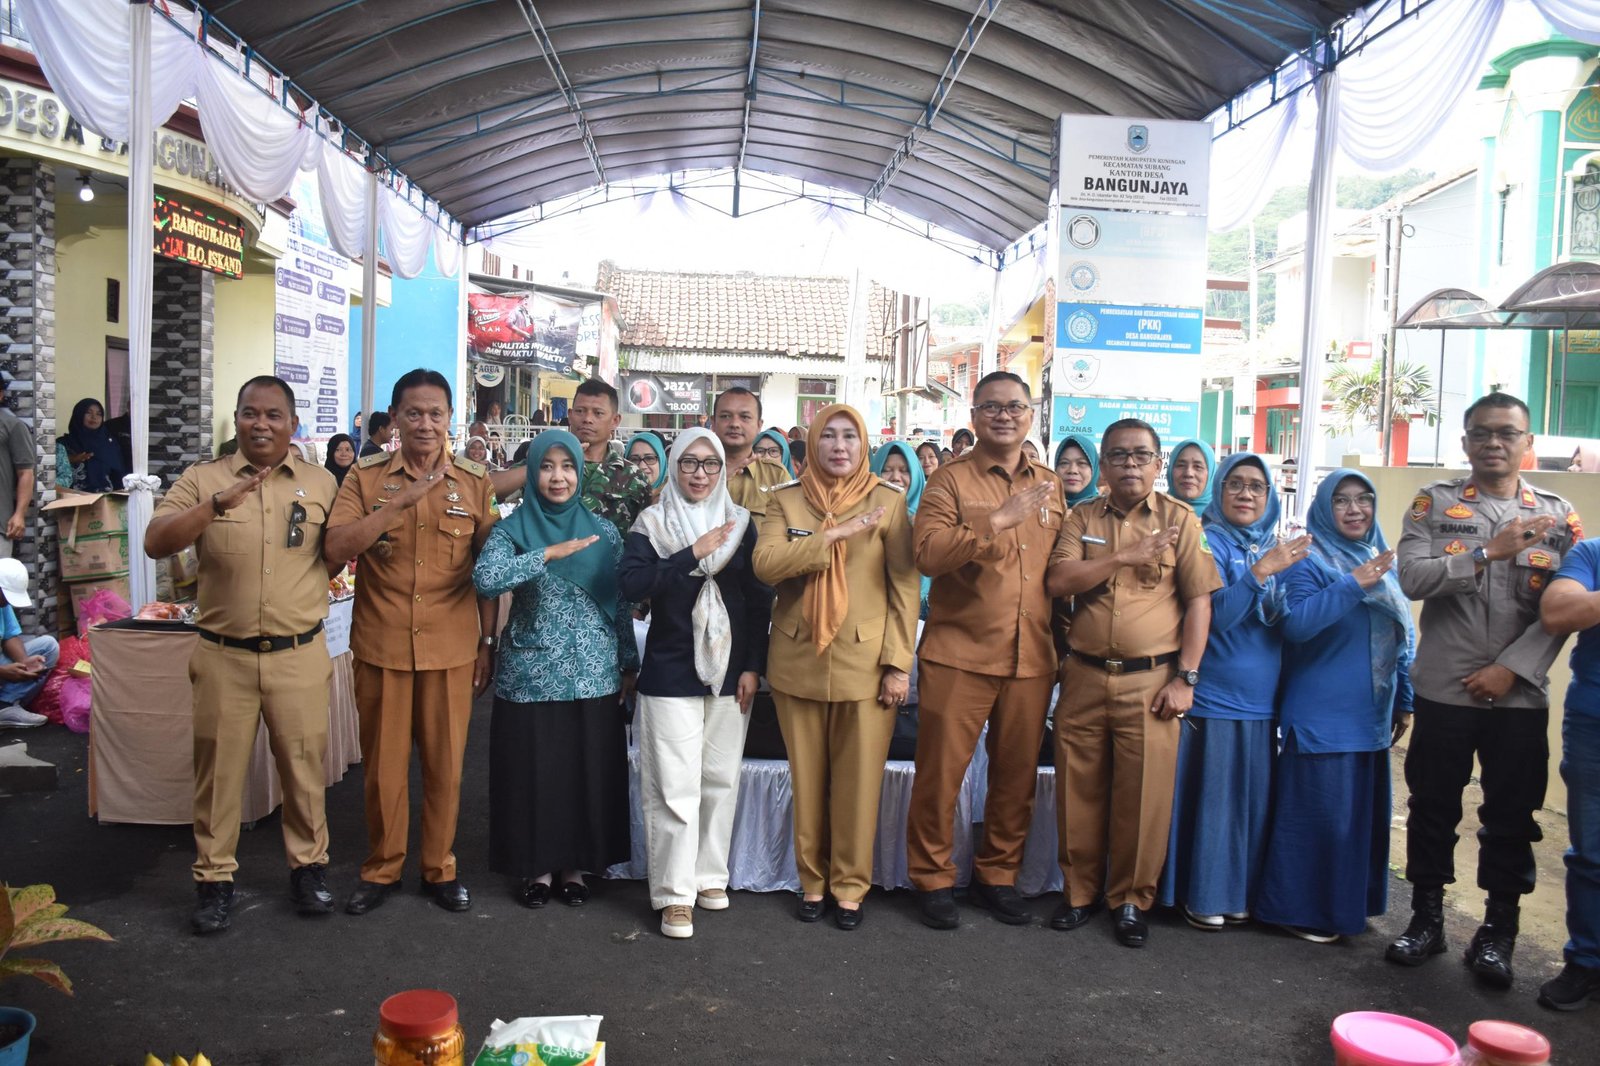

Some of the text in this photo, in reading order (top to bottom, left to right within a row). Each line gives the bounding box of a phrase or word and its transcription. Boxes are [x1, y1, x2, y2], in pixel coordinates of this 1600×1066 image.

[0, 84, 85, 145] DESA
[1103, 161, 1171, 171] KECAMATAN SUBANG
[1109, 169, 1164, 179] KANTOR DESA
[1084, 177, 1189, 196] BANGUNJAYA
[172, 212, 242, 253] BANGUNJAYA
[580, 313, 600, 326] ESS
[1138, 319, 1161, 333] (PKK)
[1125, 332, 1138, 340] DESA
[492, 341, 530, 350] KUALITAS
[485, 347, 501, 356] DARI
[537, 350, 566, 364] WAKTU
[669, 402, 700, 411] 18.000
[1099, 401, 1121, 409] BADAN
[1161, 404, 1191, 412] NASIONAL
[1119, 411, 1172, 425] (BAZNAS)
[1059, 425, 1093, 433] BAZNAS
[1440, 523, 1478, 534] SUHANDI
